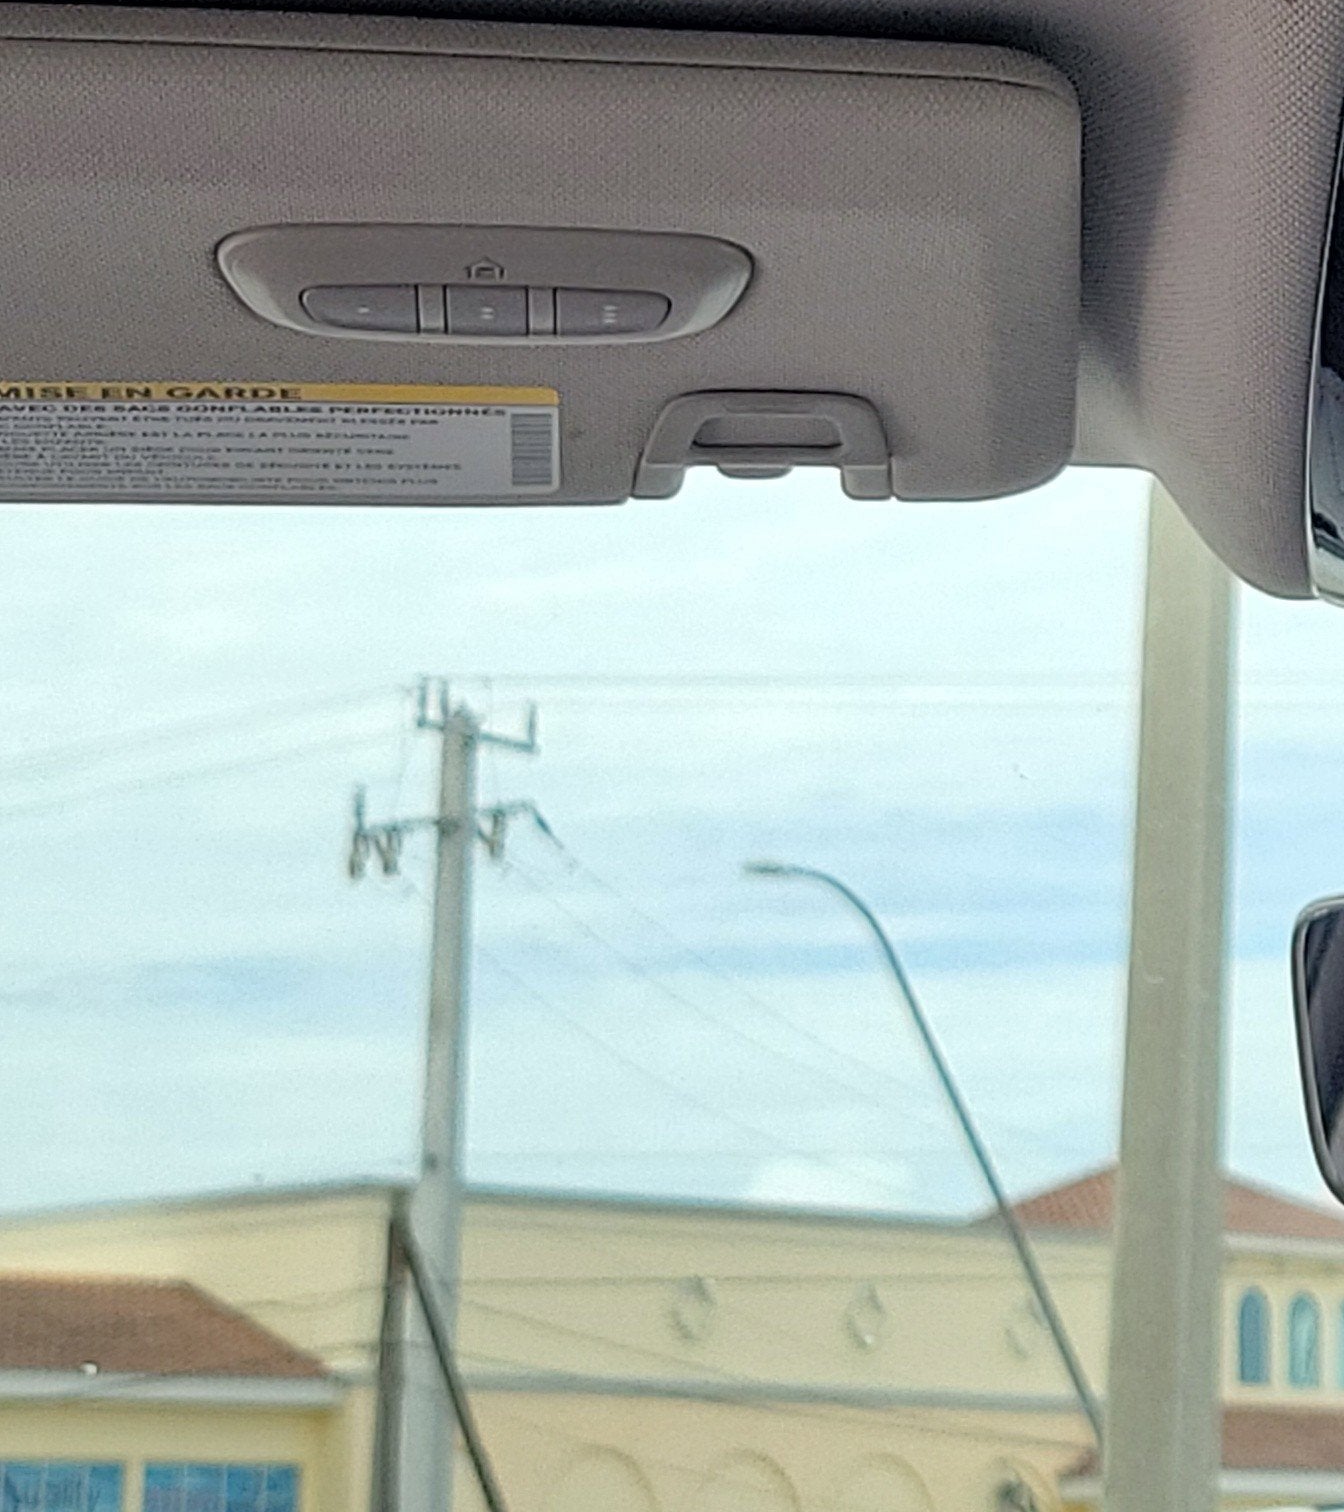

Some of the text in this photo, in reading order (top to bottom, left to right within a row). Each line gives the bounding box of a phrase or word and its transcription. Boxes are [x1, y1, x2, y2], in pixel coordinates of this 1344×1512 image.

[100, 386, 152, 399] EN
[166, 386, 302, 400] GARDE
[0, 404, 57, 413] AVEC
[63, 404, 107, 413] DES
[113, 404, 170, 413] SACS
[176, 404, 323, 414] GONFLABLES
